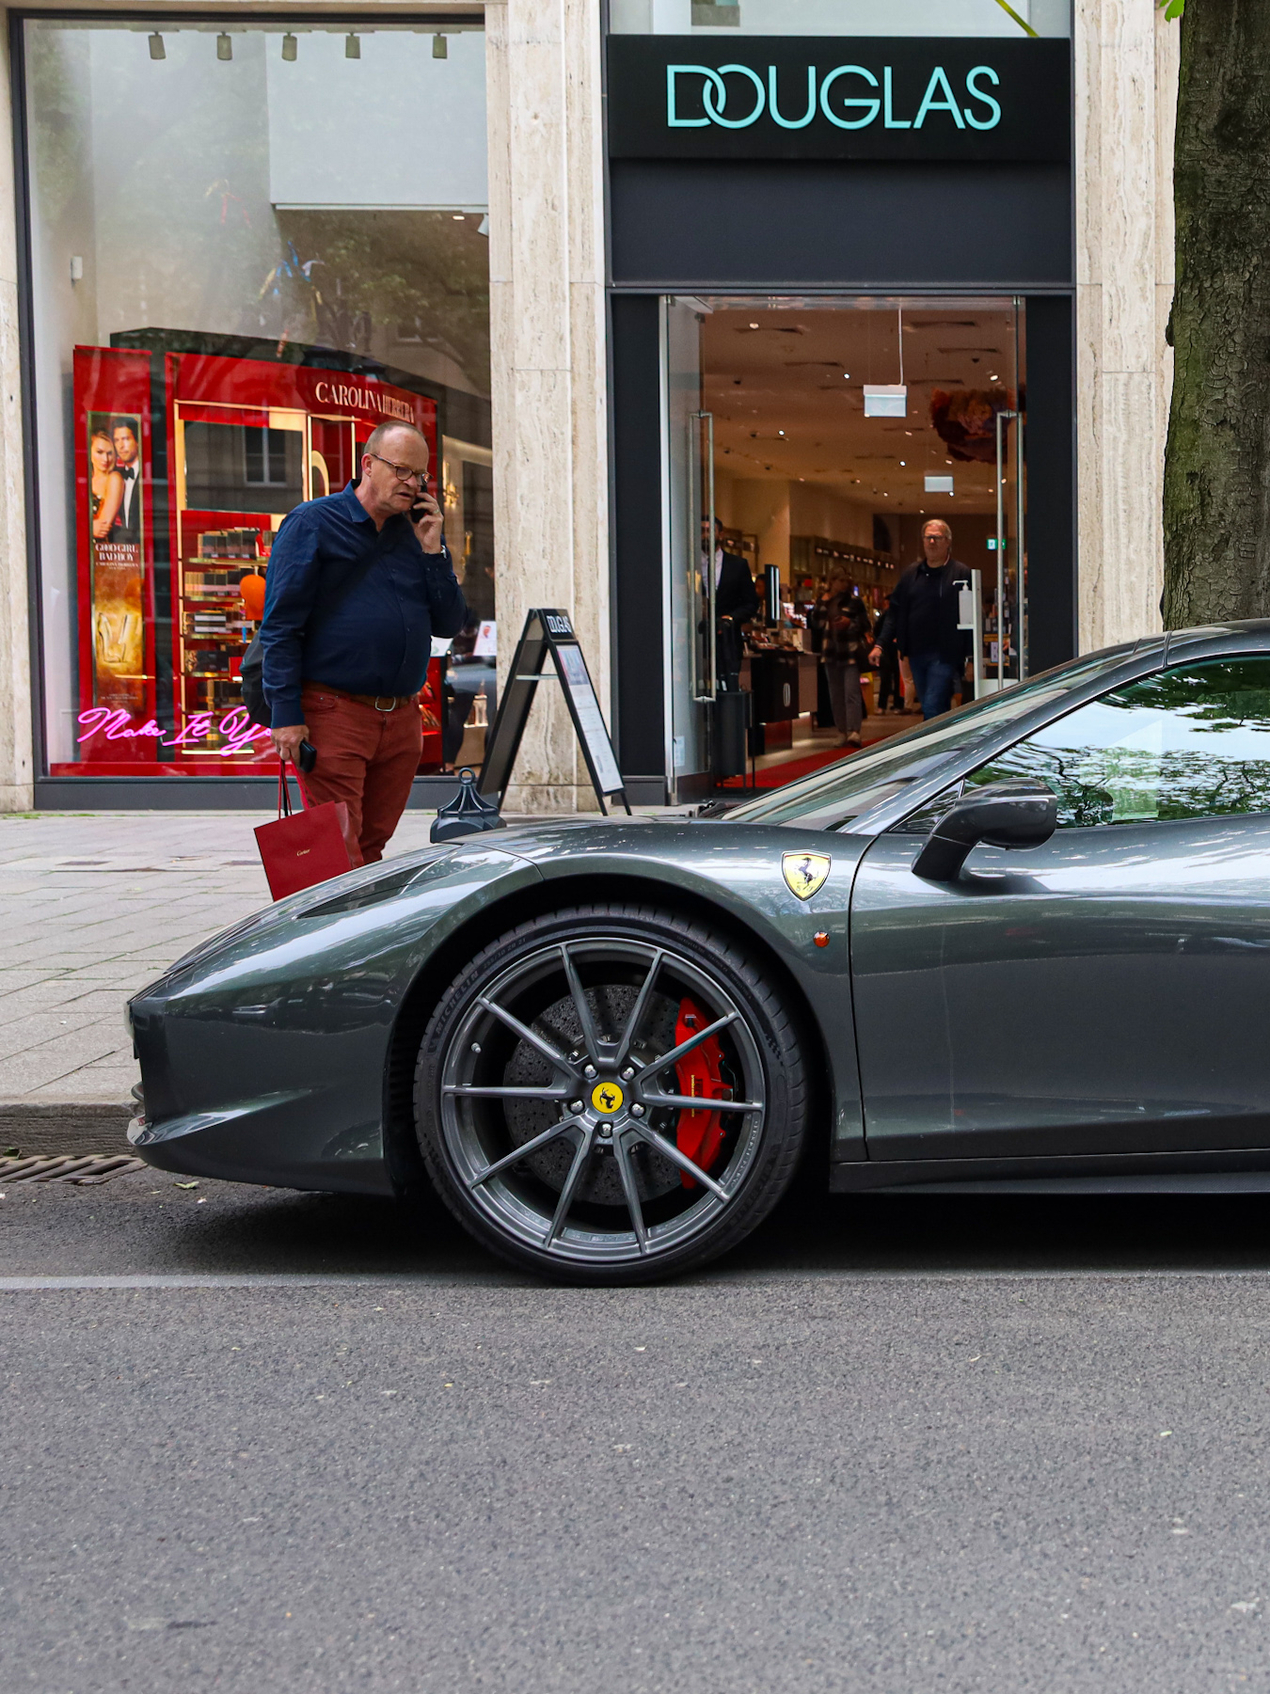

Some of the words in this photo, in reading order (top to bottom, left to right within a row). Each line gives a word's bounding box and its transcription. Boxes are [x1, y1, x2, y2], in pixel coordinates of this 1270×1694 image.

[666, 63, 1003, 131] DOUGLAS
[315, 381, 383, 413] CAROLINA
[77, 707, 167, 743] Make
[162, 710, 215, 747] It
[436, 969, 480, 1035] MICHELIN
